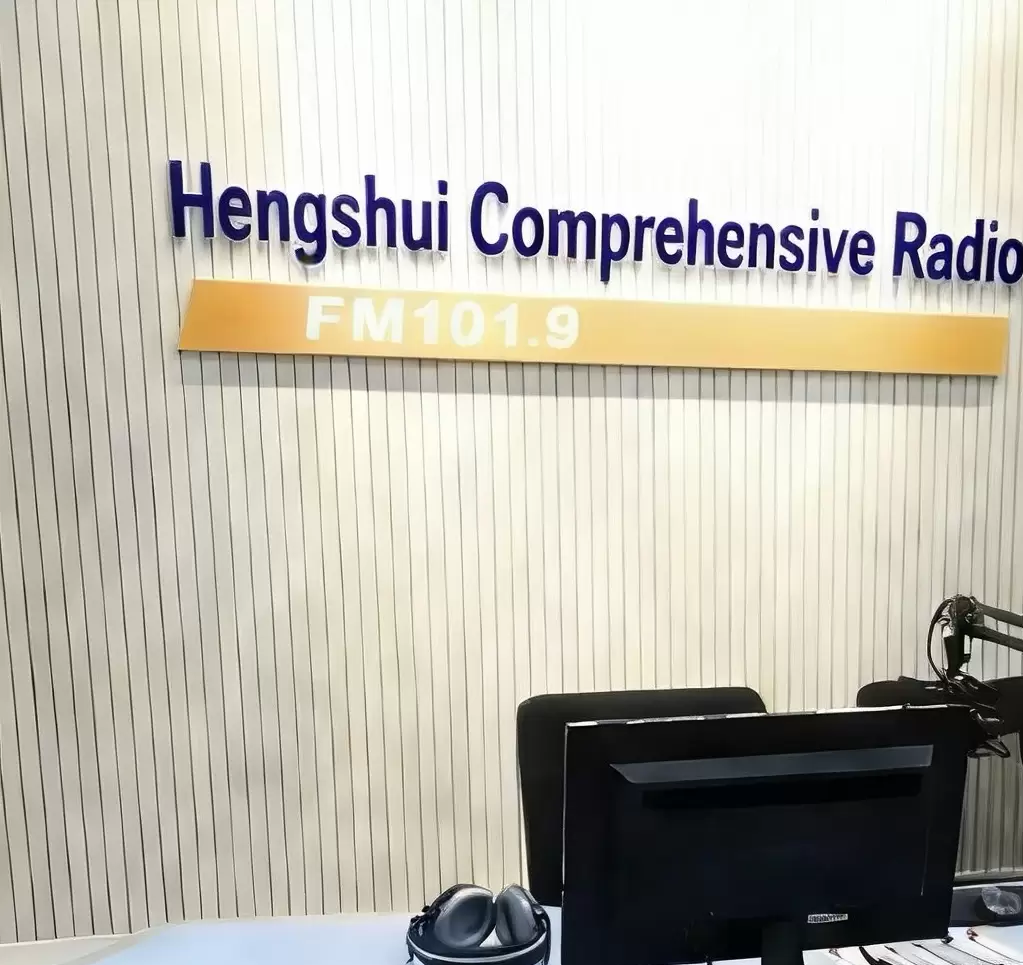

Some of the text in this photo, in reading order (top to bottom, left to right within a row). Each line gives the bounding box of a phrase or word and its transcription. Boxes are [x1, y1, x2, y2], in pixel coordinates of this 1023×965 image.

[168, 160, 448, 264] Hengshui
[470, 181, 876, 282] Comprehensive
[305, 296, 580, 349] FM101.9
